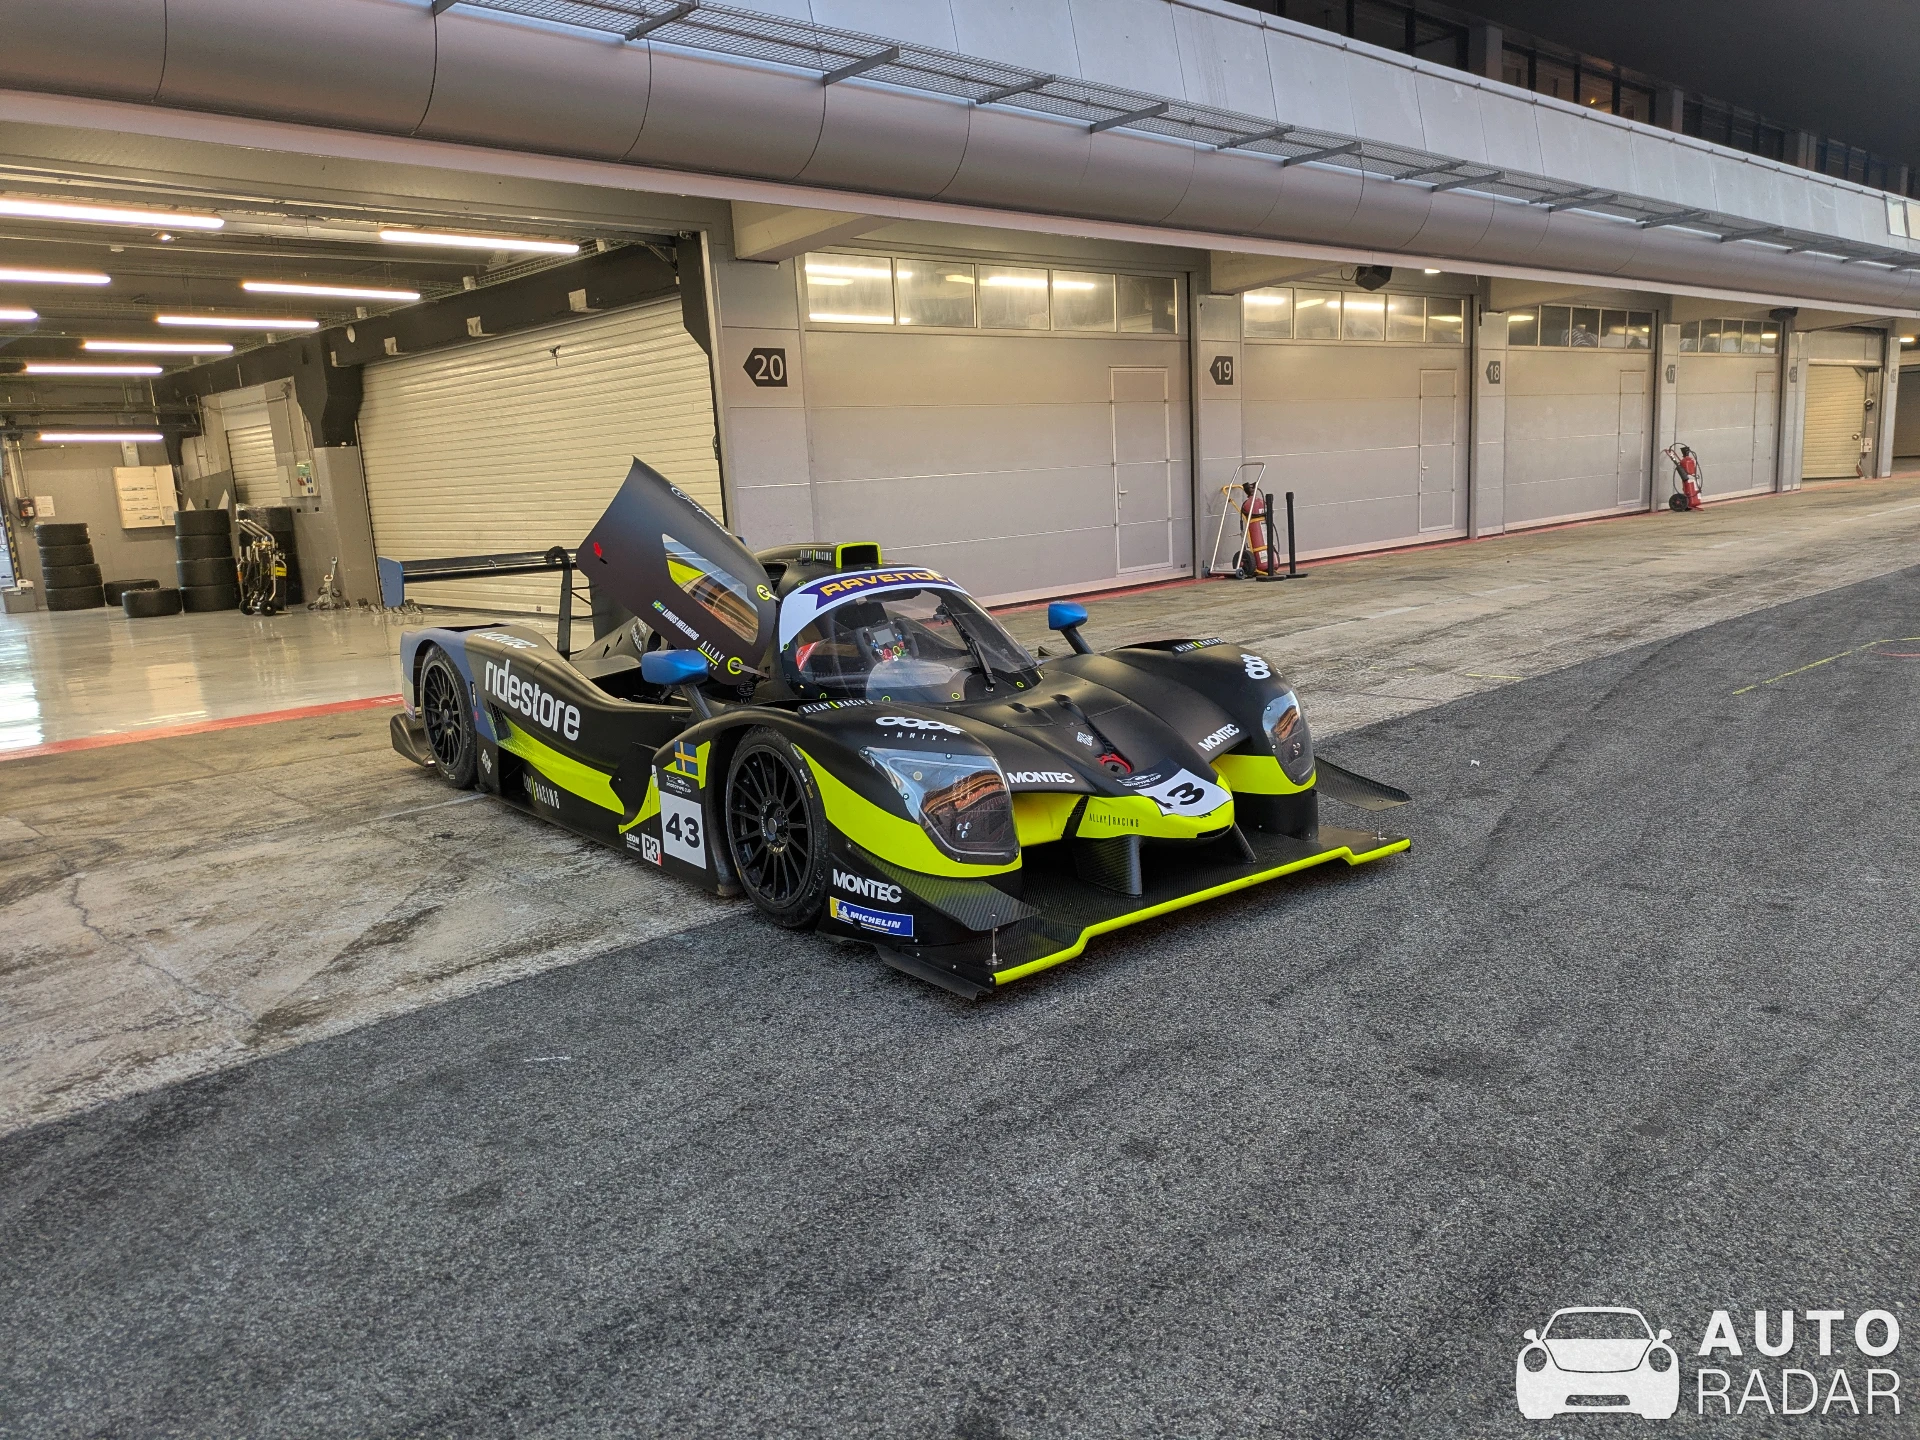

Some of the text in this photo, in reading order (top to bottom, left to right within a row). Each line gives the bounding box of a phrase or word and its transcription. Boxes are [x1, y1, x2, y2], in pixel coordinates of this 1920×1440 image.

[754, 354, 784, 381] 20
[1216, 361, 1232, 381] 19
[1490, 365, 1500, 381] 18
[820, 571, 948, 597] RAVENOL
[662, 609, 700, 641] LINUS HELLBERG
[700, 640, 725, 663] ALLAY
[485, 659, 580, 741] ridestore
[803, 699, 873, 714] ALLAY RACING
[1198, 723, 1239, 752] MONTEC
[1007, 771, 1076, 784] MONTEC
[534, 781, 560, 809] RACING
[665, 812, 701, 849] 43
[1089, 813, 1139, 828] ALLAY RACING
[626, 832, 640, 845] LEON
[833, 868, 902, 904] MONTEC
[850, 911, 902, 929] MICHELIN
